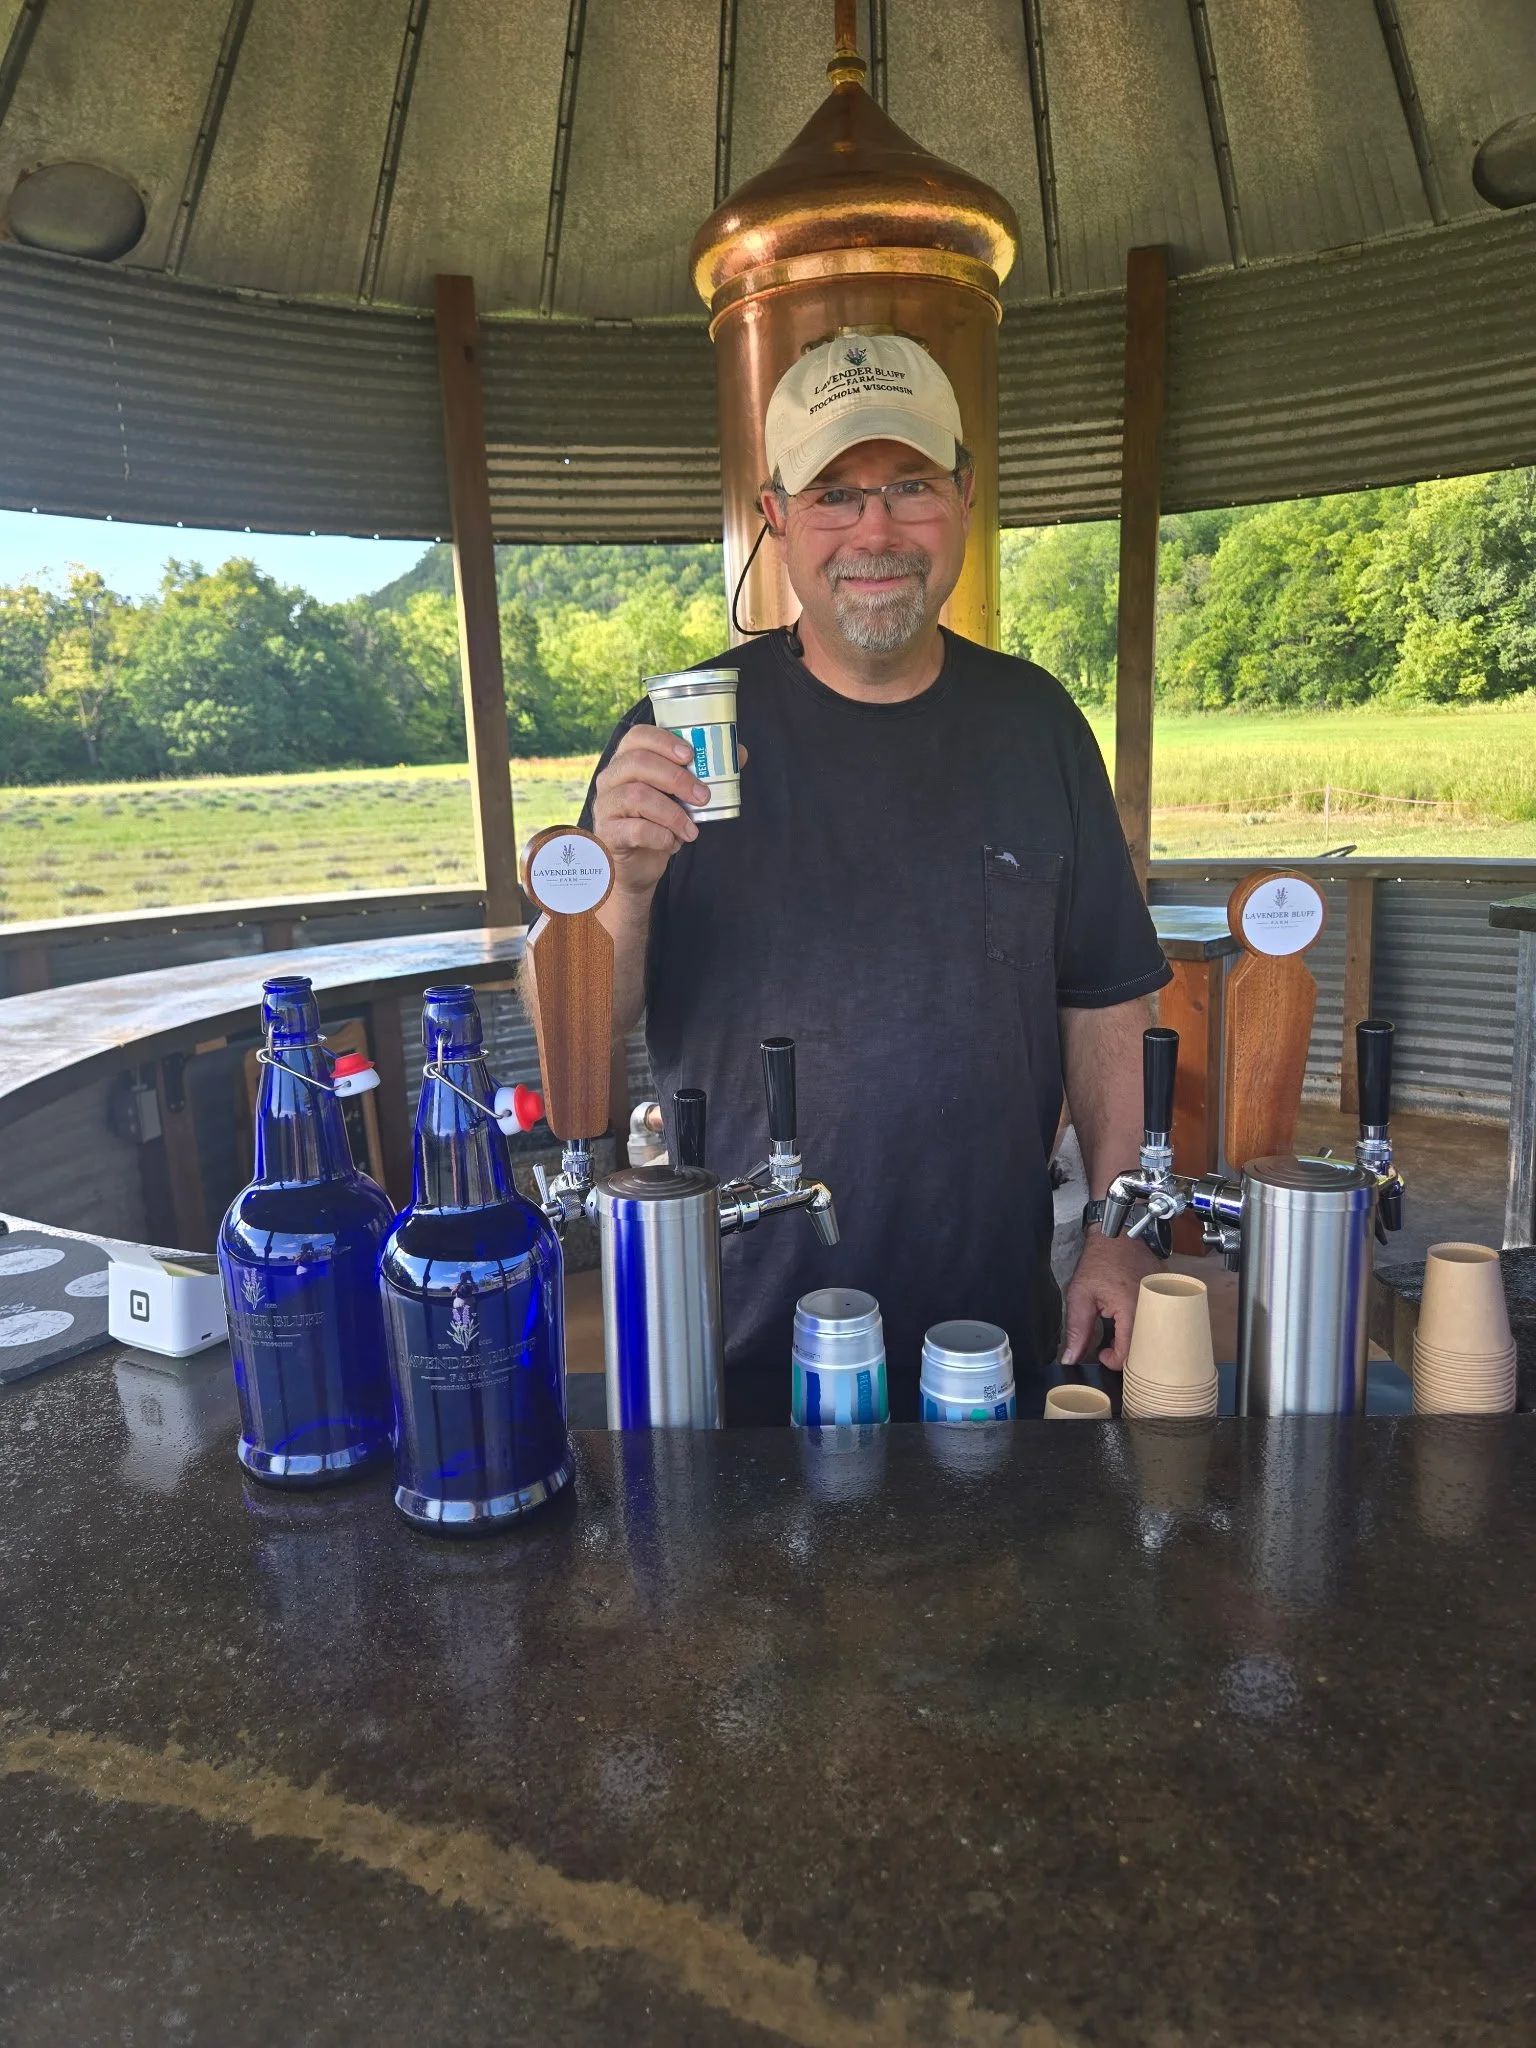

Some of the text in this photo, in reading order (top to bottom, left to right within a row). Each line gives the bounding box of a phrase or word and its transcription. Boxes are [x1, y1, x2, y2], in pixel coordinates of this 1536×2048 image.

[814, 366, 906, 395] LAVENDER BLUFF
[846, 375, 875, 386] FARM
[809, 383, 913, 415] STOCKHOLM WISCONSIN
[696, 747, 707, 776] RECYCLE
[533, 869, 577, 877] LAVENDER
[1245, 910, 1316, 920] LAVENDER BLUFF
